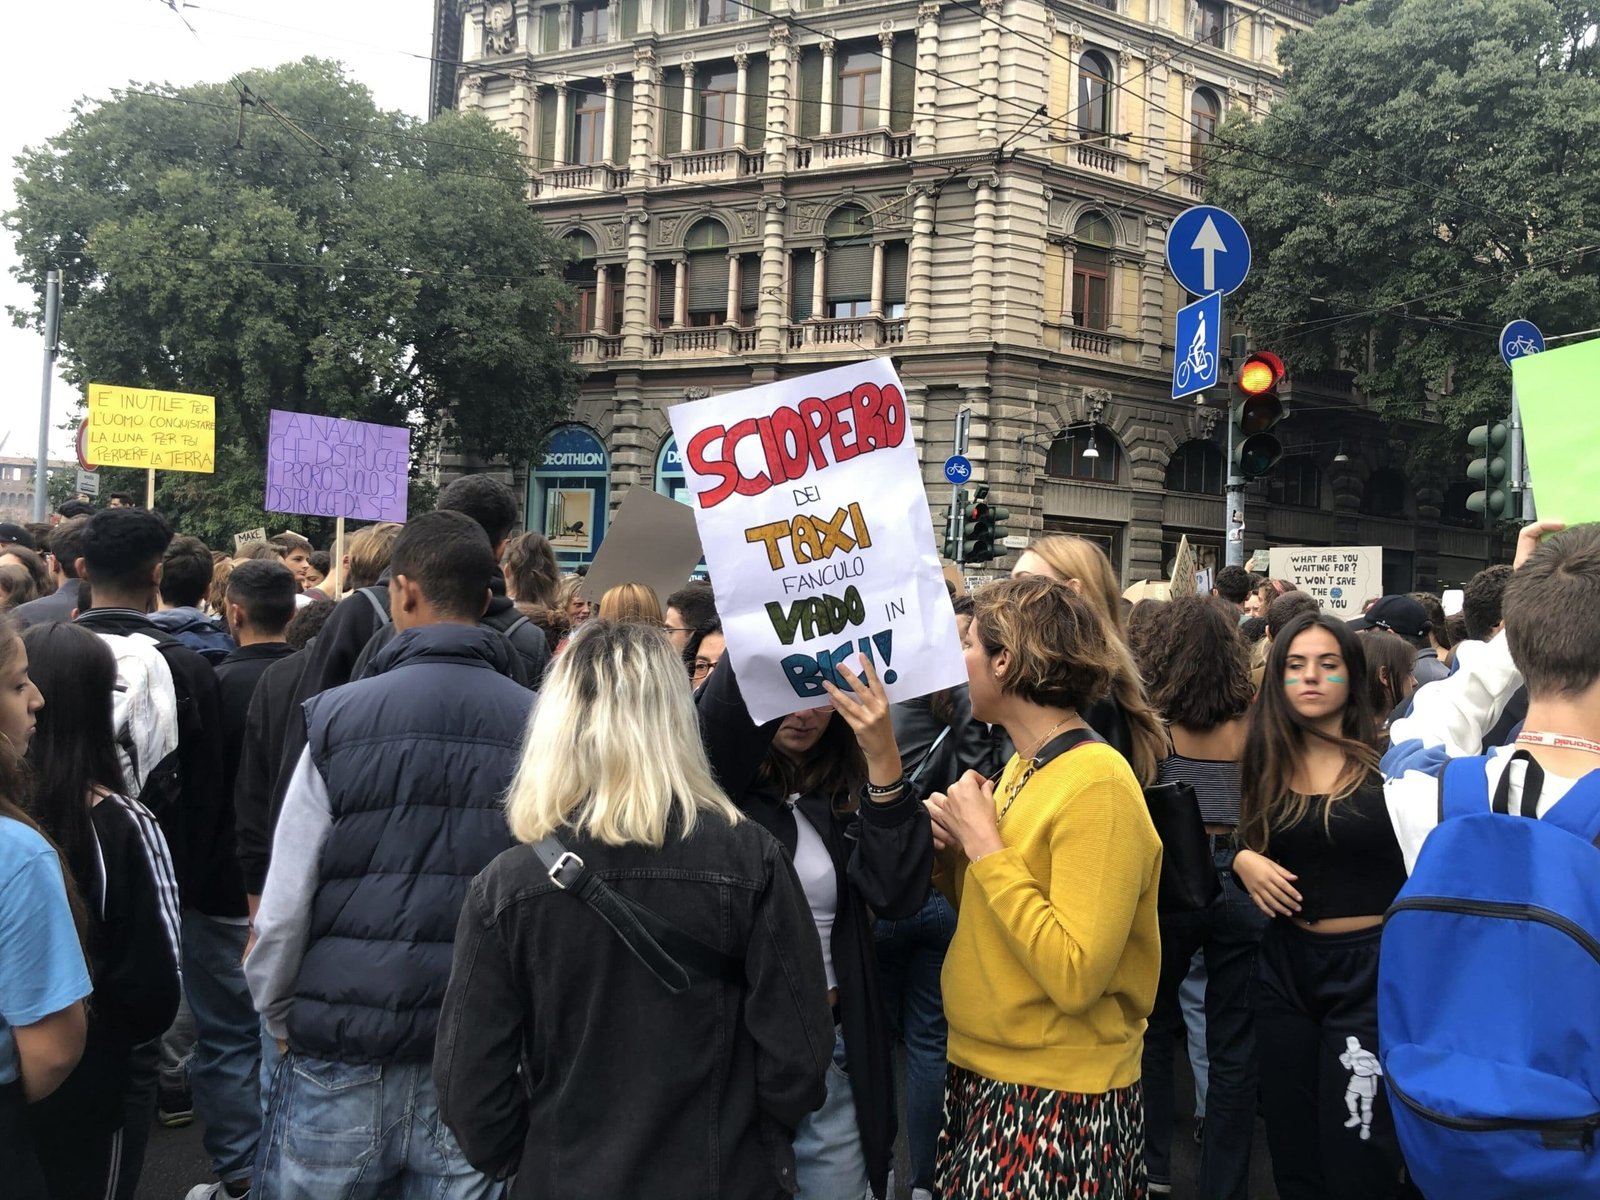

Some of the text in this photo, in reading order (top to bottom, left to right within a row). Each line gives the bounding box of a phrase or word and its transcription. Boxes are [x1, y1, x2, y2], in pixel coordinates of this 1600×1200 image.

[121, 394, 186, 411] INUTILE
[189, 400, 209, 414] PER
[92, 412, 216, 431] L'UOMO CONQUISTARE
[271, 411, 394, 450] LA NAZIONE
[91, 432, 199, 447] LA LUNA PER POI
[687, 382, 906, 509] SCIOPERO
[93, 446, 213, 468] PERDERE LA TERRA
[270, 436, 409, 476] CHE DISTRUGGE
[541, 452, 604, 465] DECATHLON
[334, 467, 381, 496] SUOLO
[266, 485, 343, 516] DISTRUGGE
[344, 492, 364, 518] DA
[793, 486, 821, 506] DEI
[238, 530, 262, 542] MAKE
[745, 502, 872, 571] TAXI
[1290, 554, 1359, 563] WHAT ARE YOU
[1293, 564, 1330, 572] WAITING
[782, 557, 865, 594] FANCULO
[1295, 573, 1357, 586] I WON'T SAVE
[1311, 587, 1328, 596] THE
[1330, 599, 1347, 609] YOU
[765, 585, 906, 645] VADO IN
